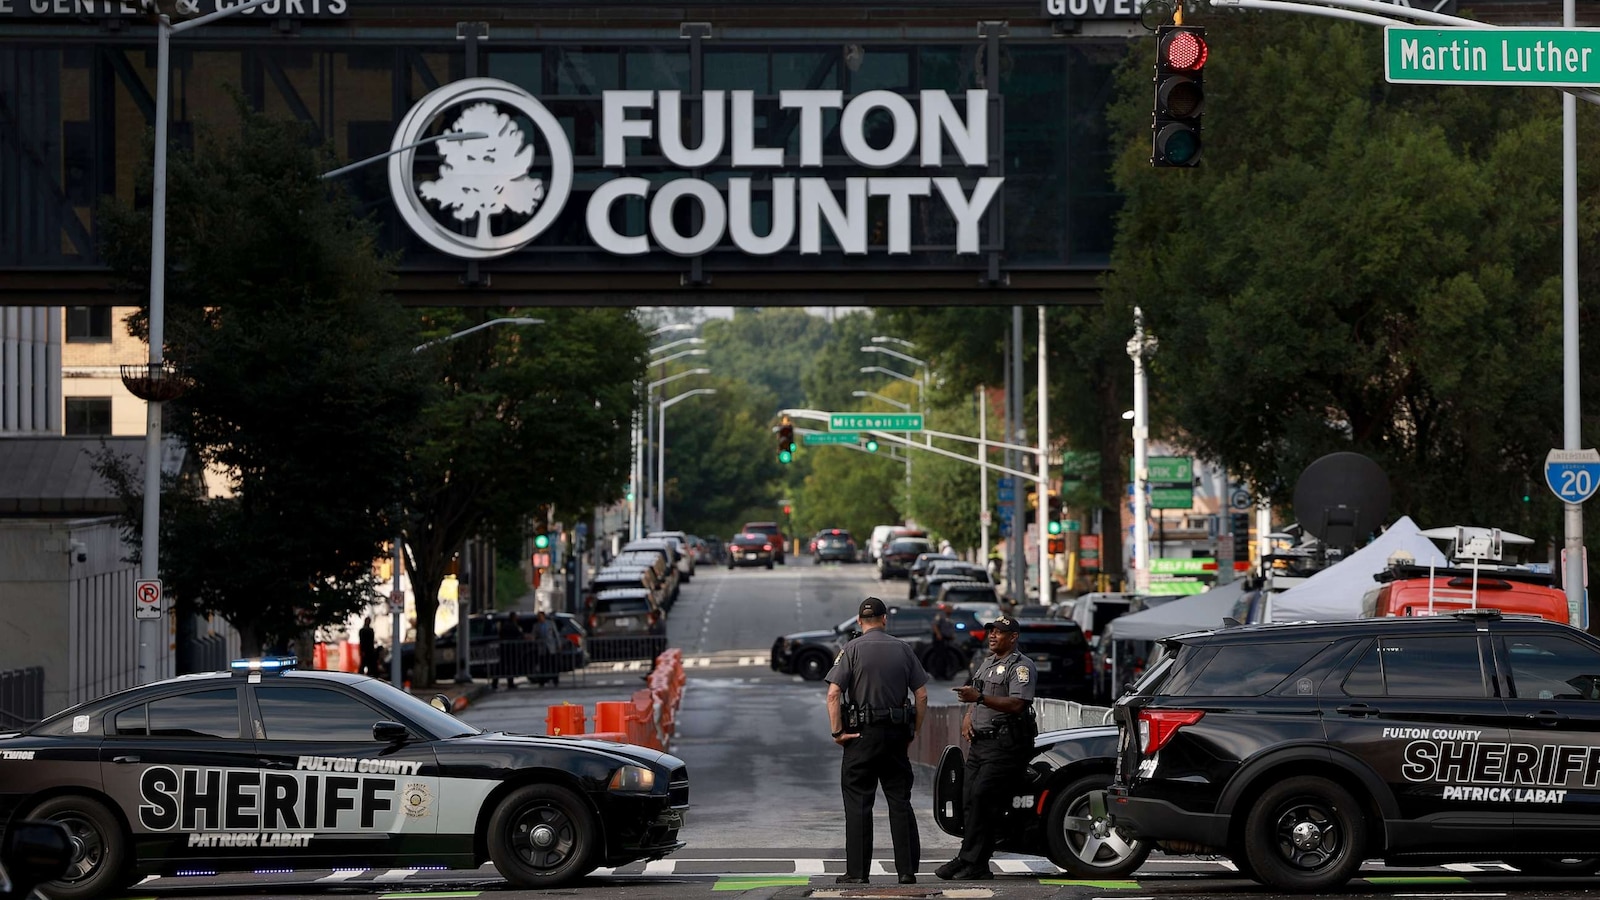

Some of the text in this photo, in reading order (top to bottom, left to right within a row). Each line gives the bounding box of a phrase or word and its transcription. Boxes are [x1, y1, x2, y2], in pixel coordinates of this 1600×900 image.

[1401, 38, 1592, 72] Martin Luther
[602, 89, 989, 169] FULTON
[585, 176, 1006, 258] COUNTY
[833, 418, 892, 427] Mitchell
[1561, 470, 1592, 496] 20
[1157, 561, 1182, 571] SELF
[1382, 727, 1482, 741] FULTON COUNTY
[297, 756, 423, 776] FULTON COUNTY
[138, 765, 397, 832] SHERIFF
[1012, 795, 1035, 809] 815
[1442, 786, 1568, 804] PATRICK LABAT
[188, 833, 315, 848] PATRICK LABAT
